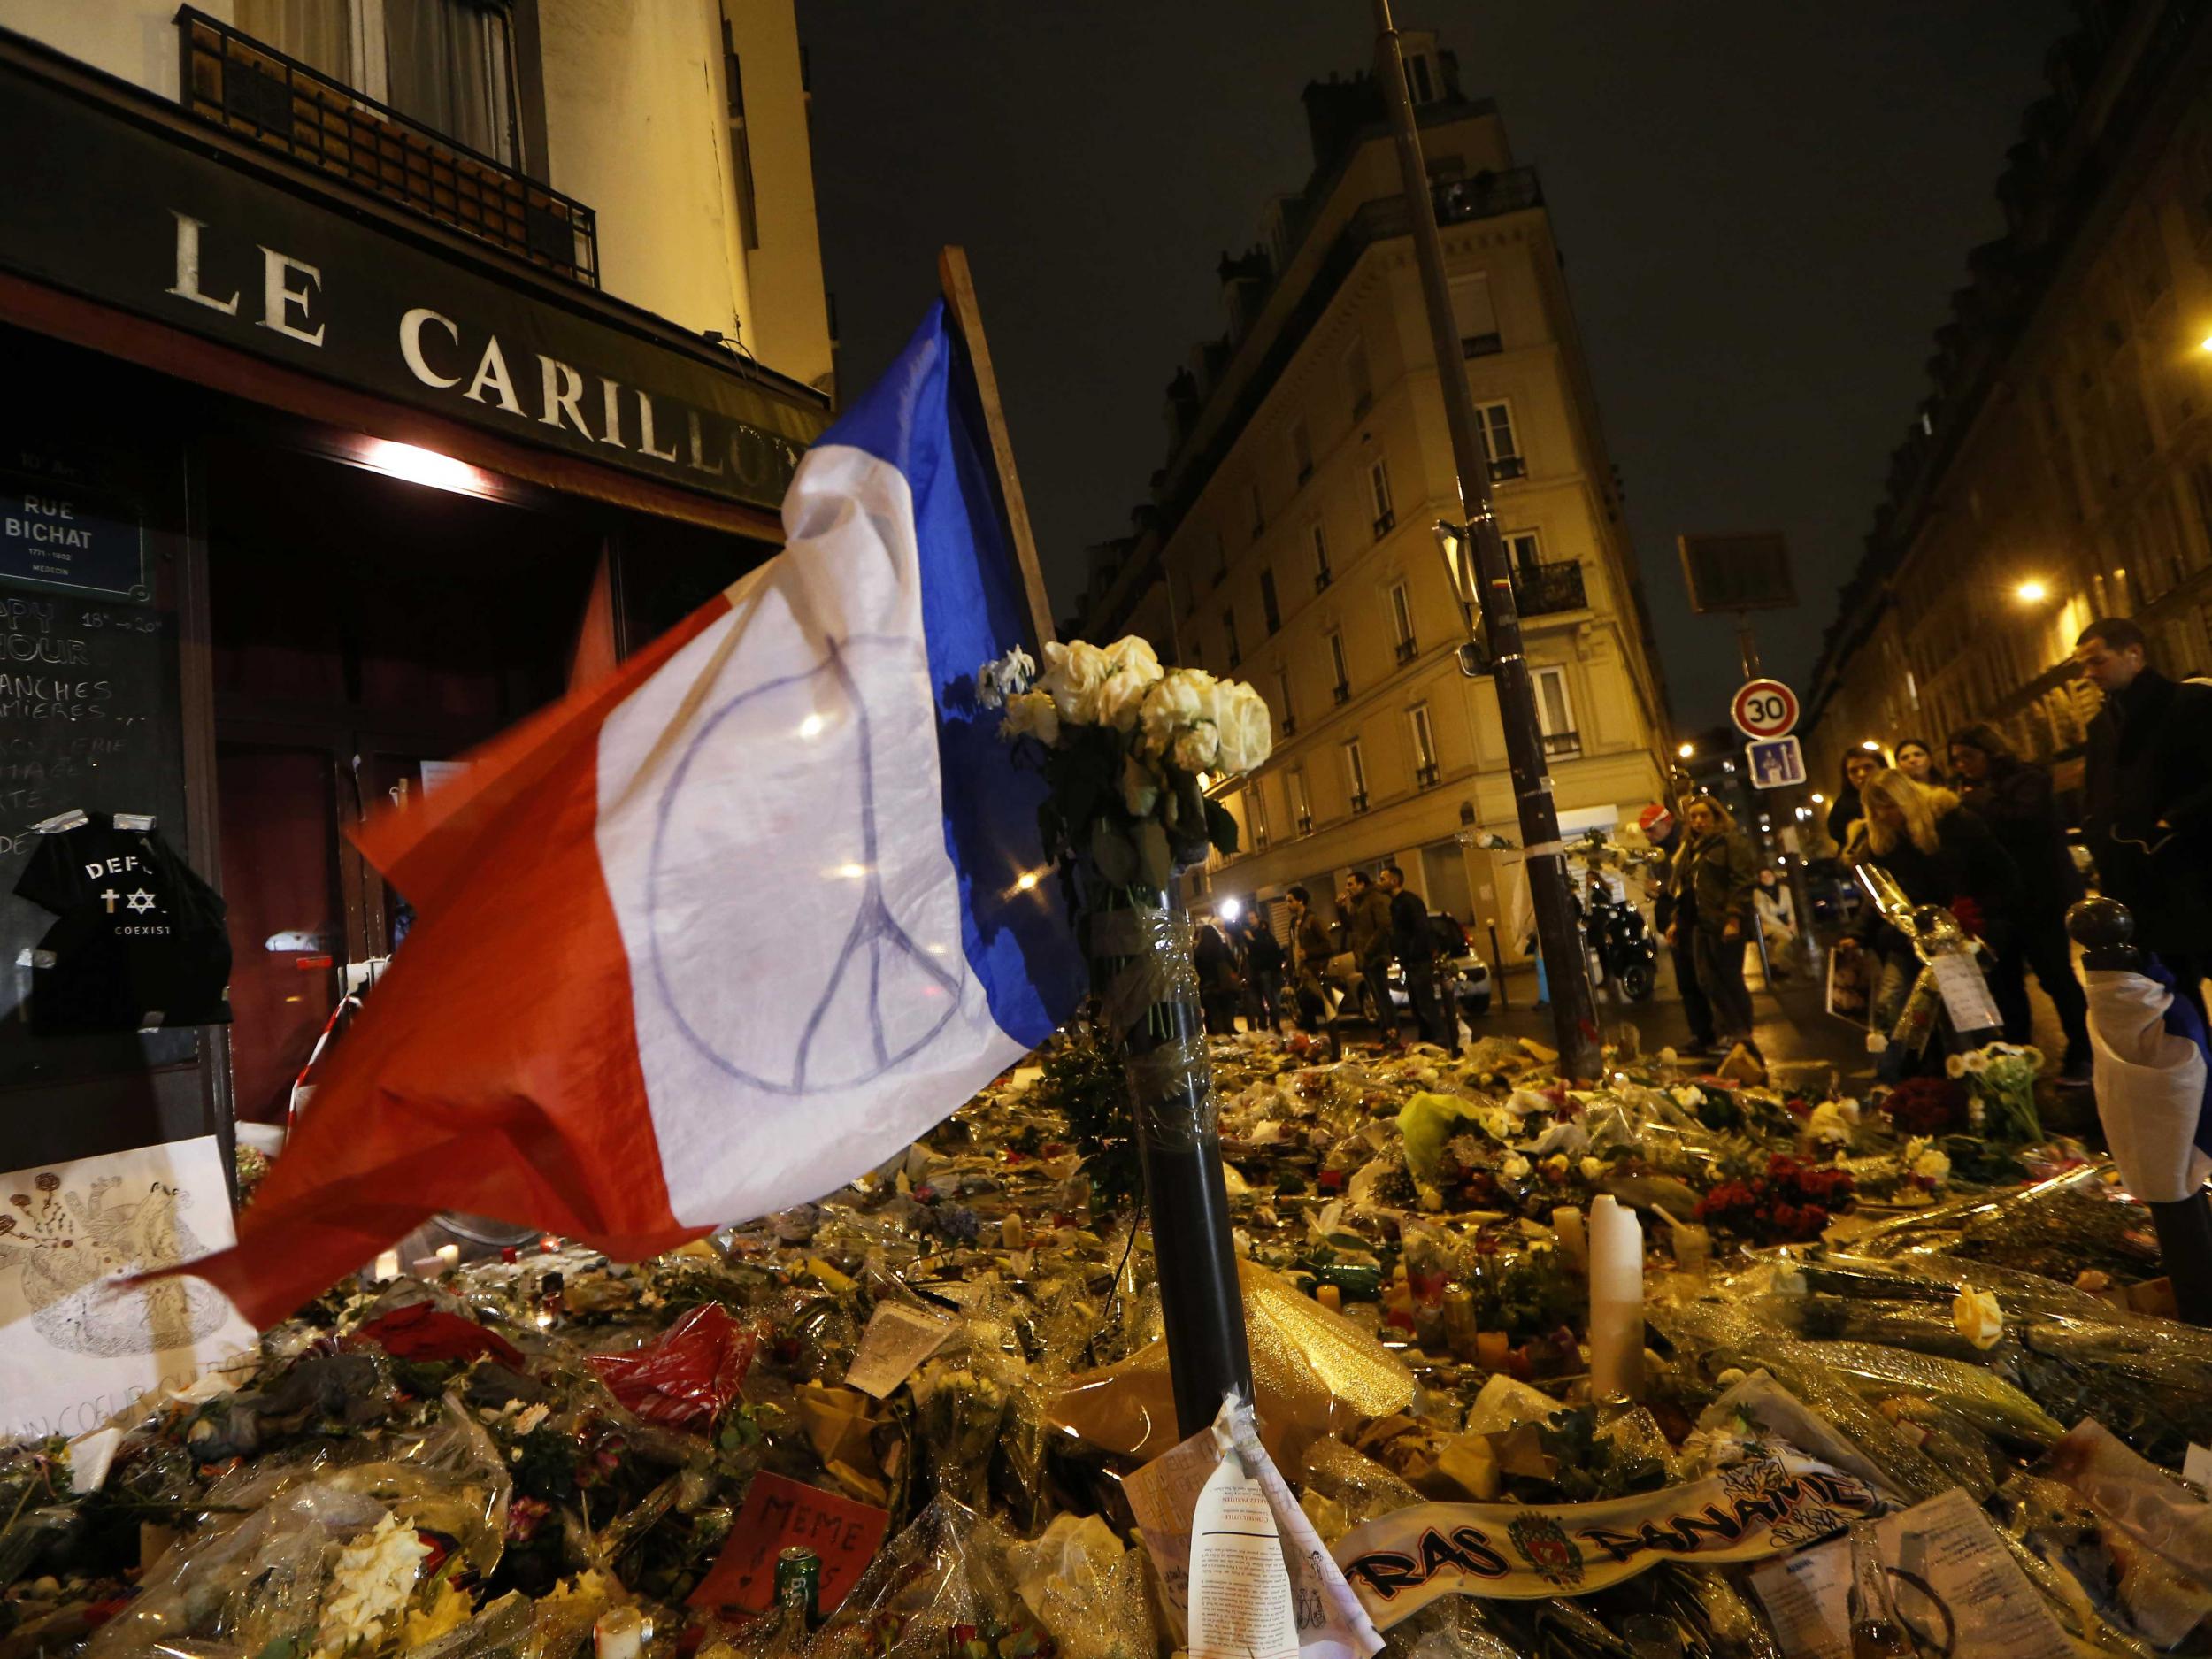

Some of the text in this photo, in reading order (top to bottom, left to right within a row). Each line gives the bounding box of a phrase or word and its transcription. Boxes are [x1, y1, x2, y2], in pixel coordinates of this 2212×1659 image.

[165, 209, 326, 347] LE
[24, 495, 74, 520] RUE
[4, 518, 92, 549] BICHAT
[1747, 696, 1784, 723] 30
[114, 926, 171, 935] COEXIST
[1344, 1526, 1511, 1601] RAS
